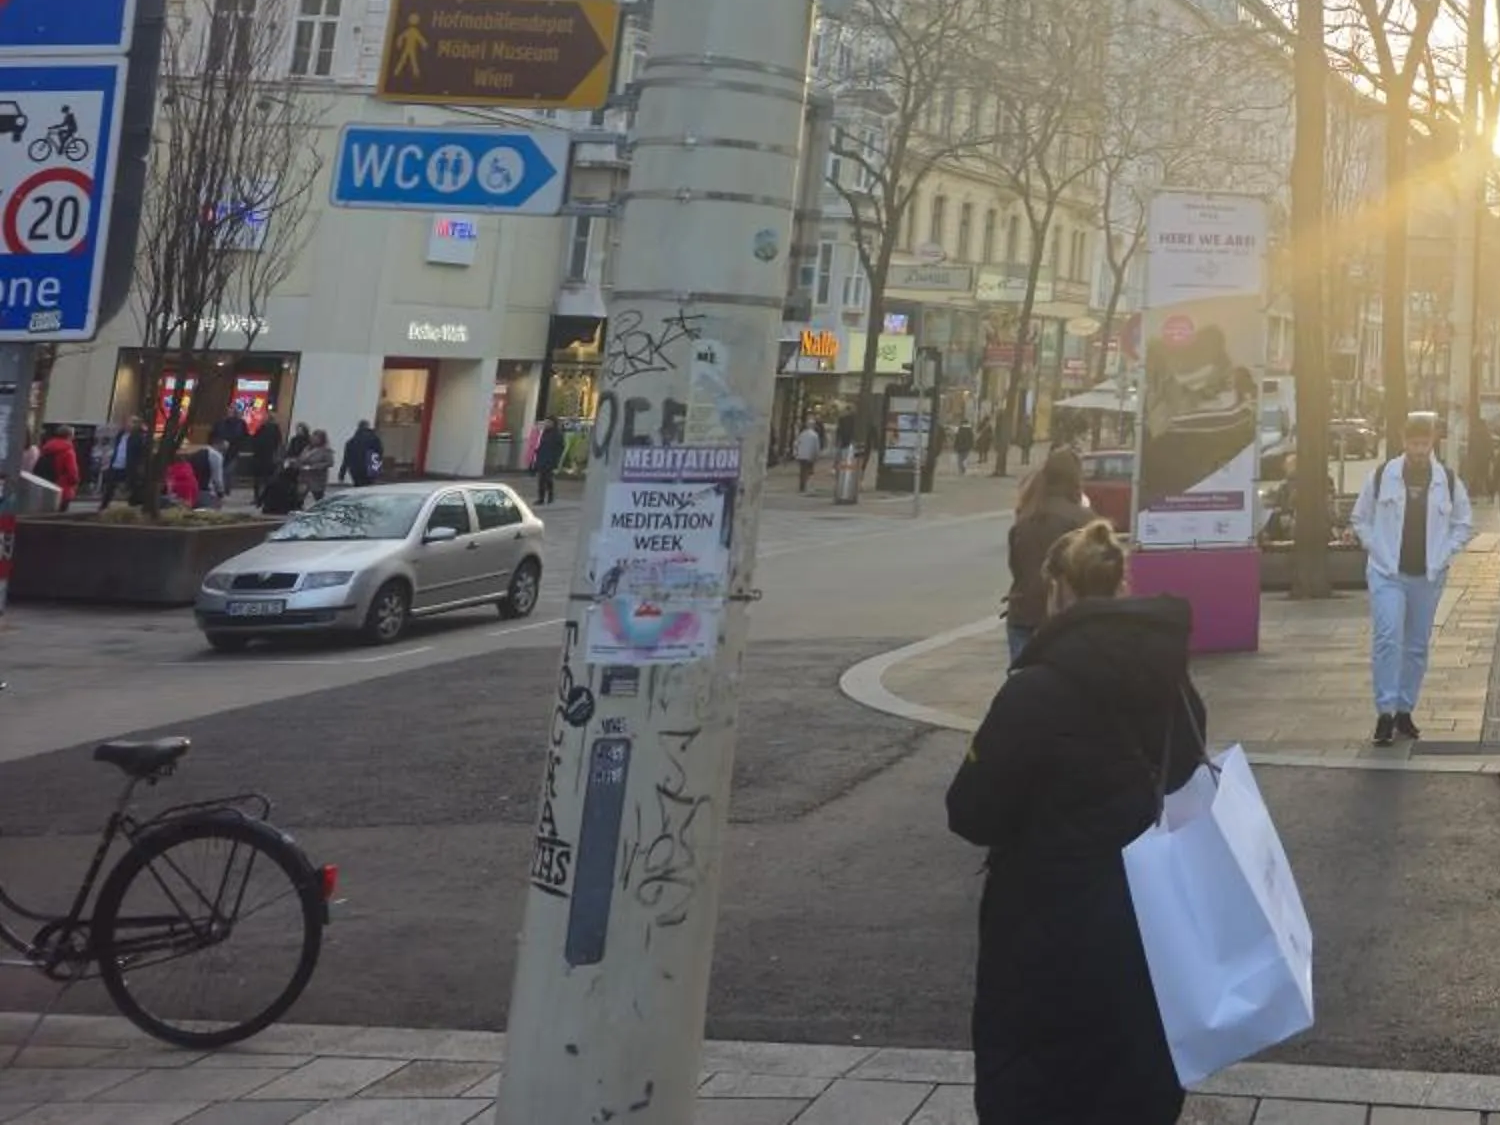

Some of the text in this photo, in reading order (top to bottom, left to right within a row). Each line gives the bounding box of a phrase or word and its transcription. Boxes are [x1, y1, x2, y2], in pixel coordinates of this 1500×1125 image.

[491, 41, 559, 63] Museum
[474, 67, 514, 88] Wien
[351, 143, 424, 190] WC
[27, 195, 80, 241] 20
[1199, 233, 1221, 246] WE
[0, 275, 61, 307] ne
[624, 448, 740, 470] MEDITATION
[631, 490, 696, 509] VIENNA
[610, 512, 714, 529] MEDITATION
[633, 534, 684, 552] WEEK
